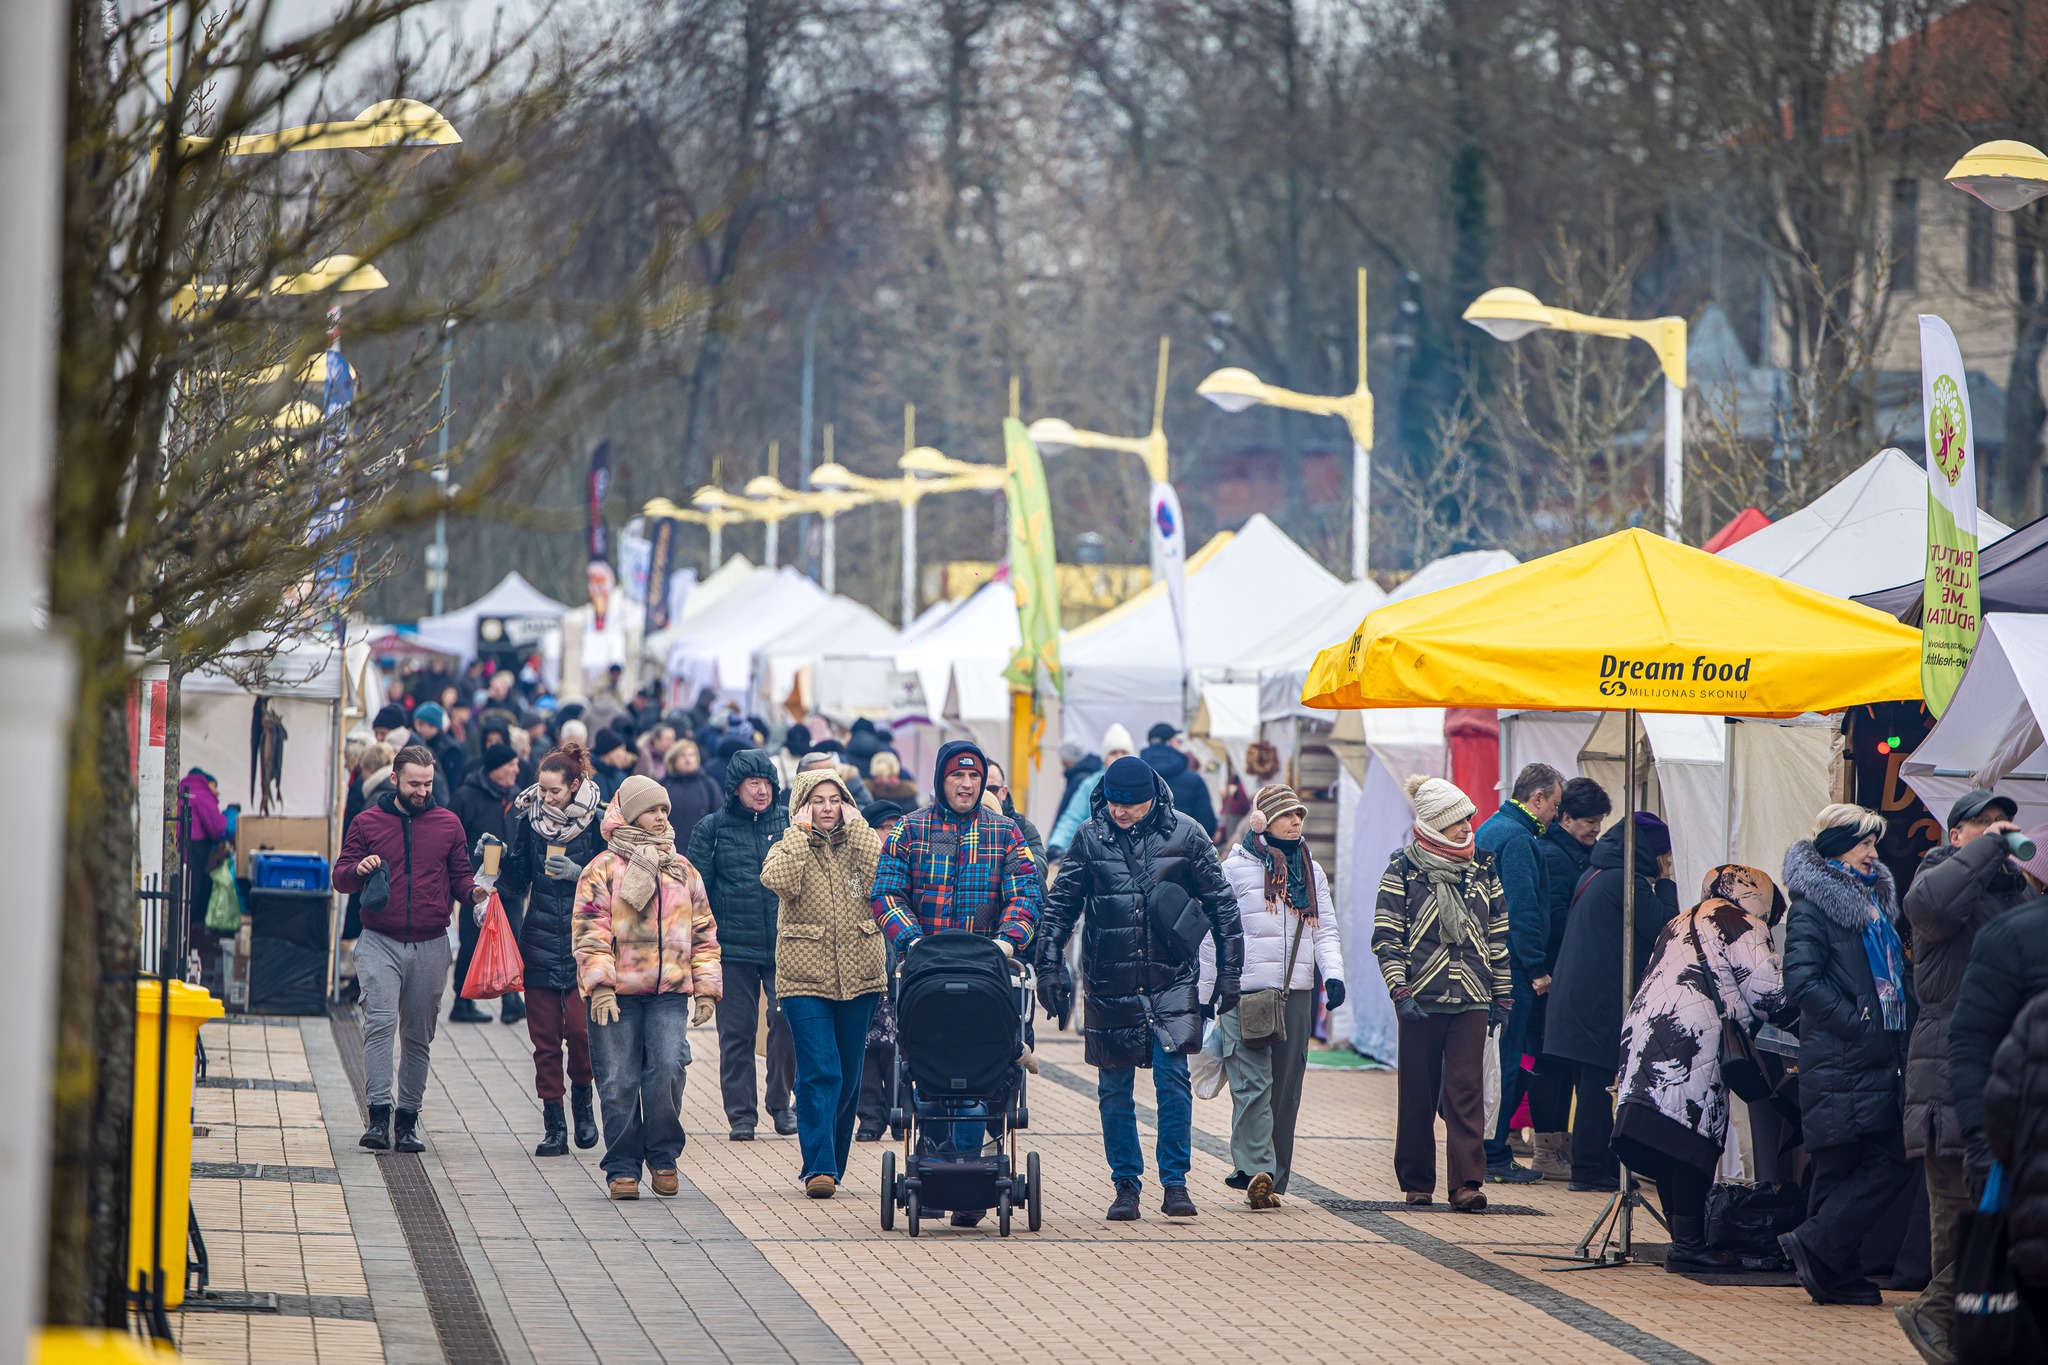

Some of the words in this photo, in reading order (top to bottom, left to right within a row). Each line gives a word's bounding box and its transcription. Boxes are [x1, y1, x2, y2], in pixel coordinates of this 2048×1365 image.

[1600, 654, 1684, 681] Dream
[1691, 655, 1752, 682] food
[1629, 688, 1696, 698] MILIJONAS
[1700, 689, 1747, 701] SKONIŲ
